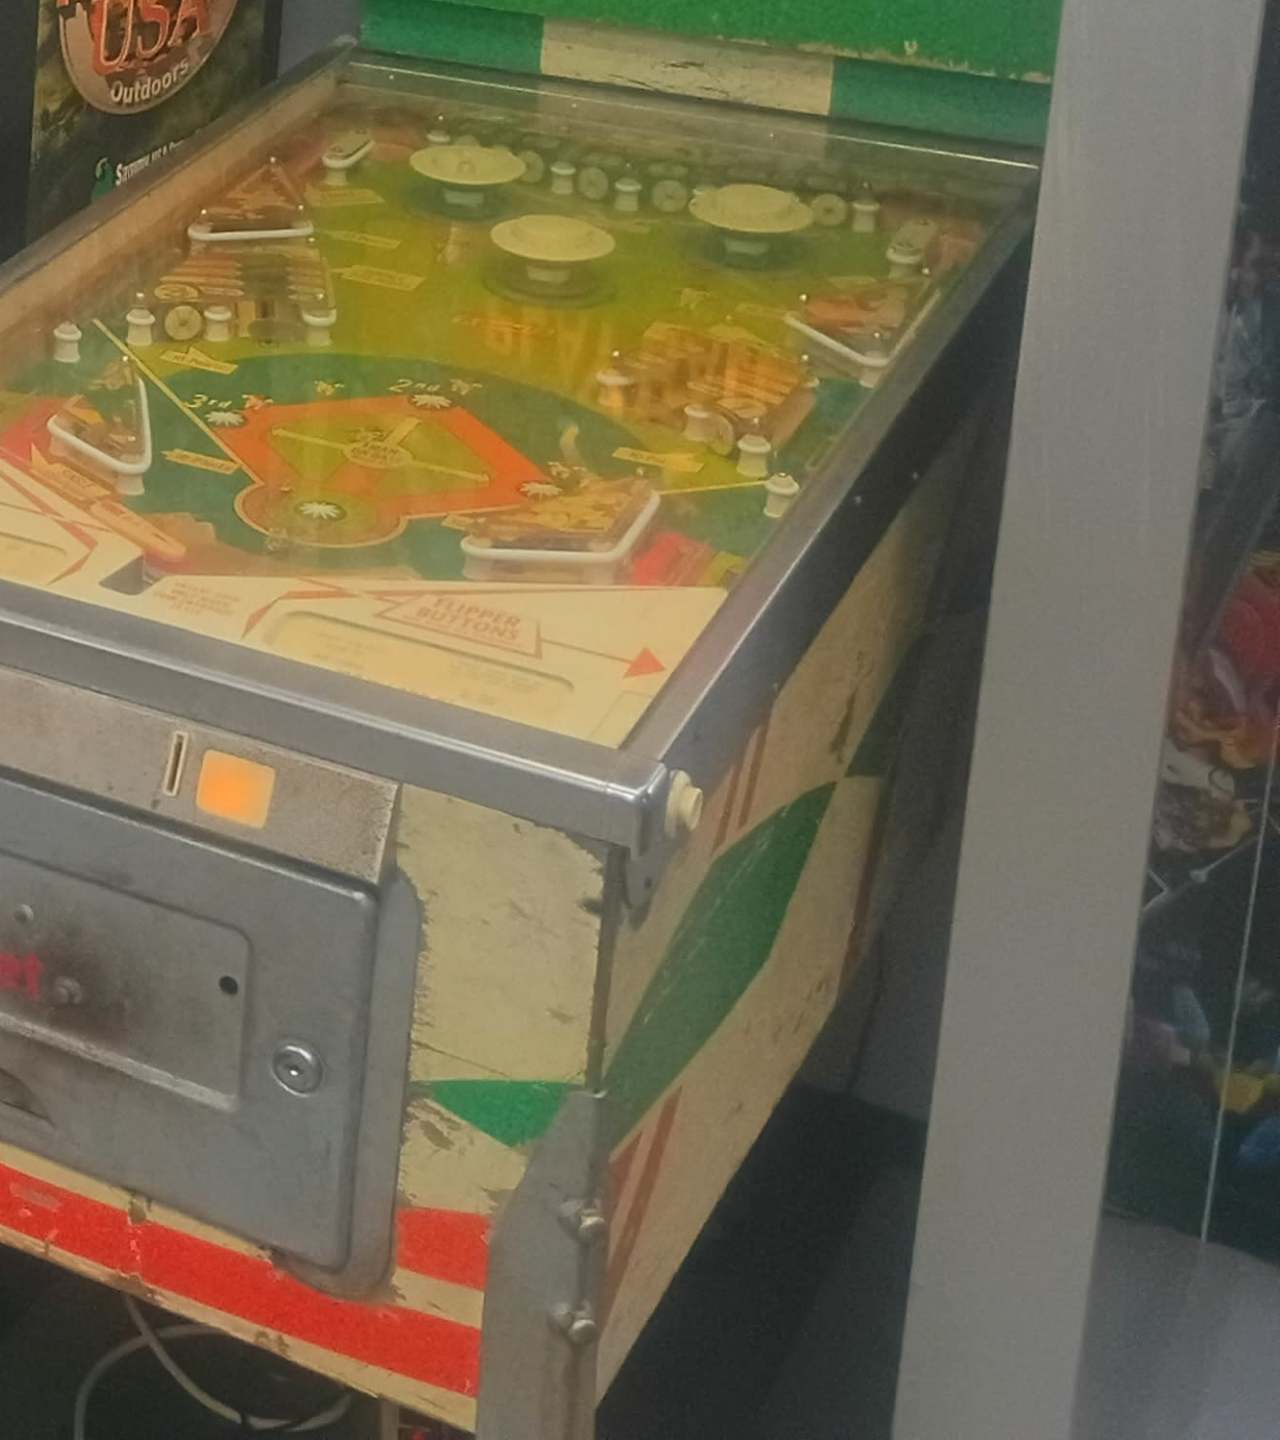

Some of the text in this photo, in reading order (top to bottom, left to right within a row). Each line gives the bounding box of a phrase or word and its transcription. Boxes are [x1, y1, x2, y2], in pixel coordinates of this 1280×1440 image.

[110, 59, 190, 104] Outdoors
[184, 394, 233, 410] 3rd
[416, 606, 519, 641] BUTTONS
[434, 596, 522, 627] FLIPPER
